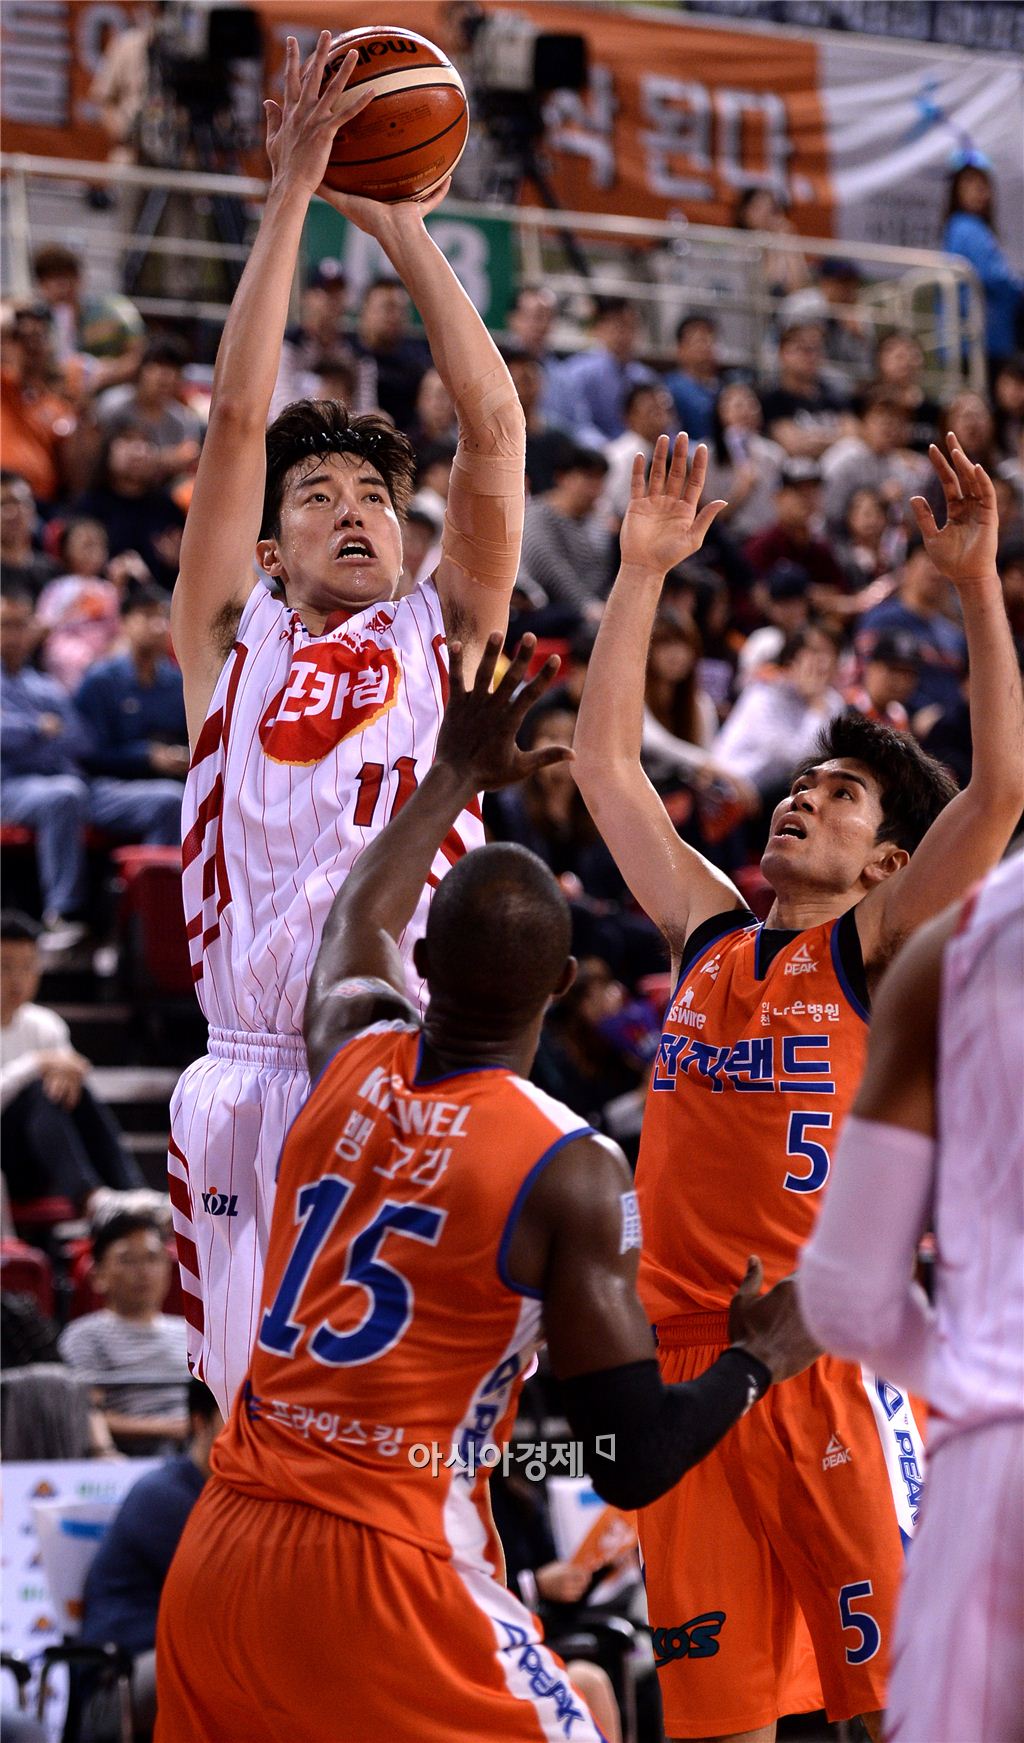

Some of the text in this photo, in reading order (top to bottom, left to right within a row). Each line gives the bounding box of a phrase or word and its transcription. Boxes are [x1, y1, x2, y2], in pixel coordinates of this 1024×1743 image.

[324, 39, 418, 81] mole
[353, 756, 419, 827] 11
[783, 960, 820, 976] PEAK
[653, 1033, 836, 1094] 전자랜드
[783, 1110, 832, 1194] 5
[256, 1173, 449, 1368] 15
[266, 1399, 405, 1457] 프라이스킹
[838, 1580, 881, 1665] 5
